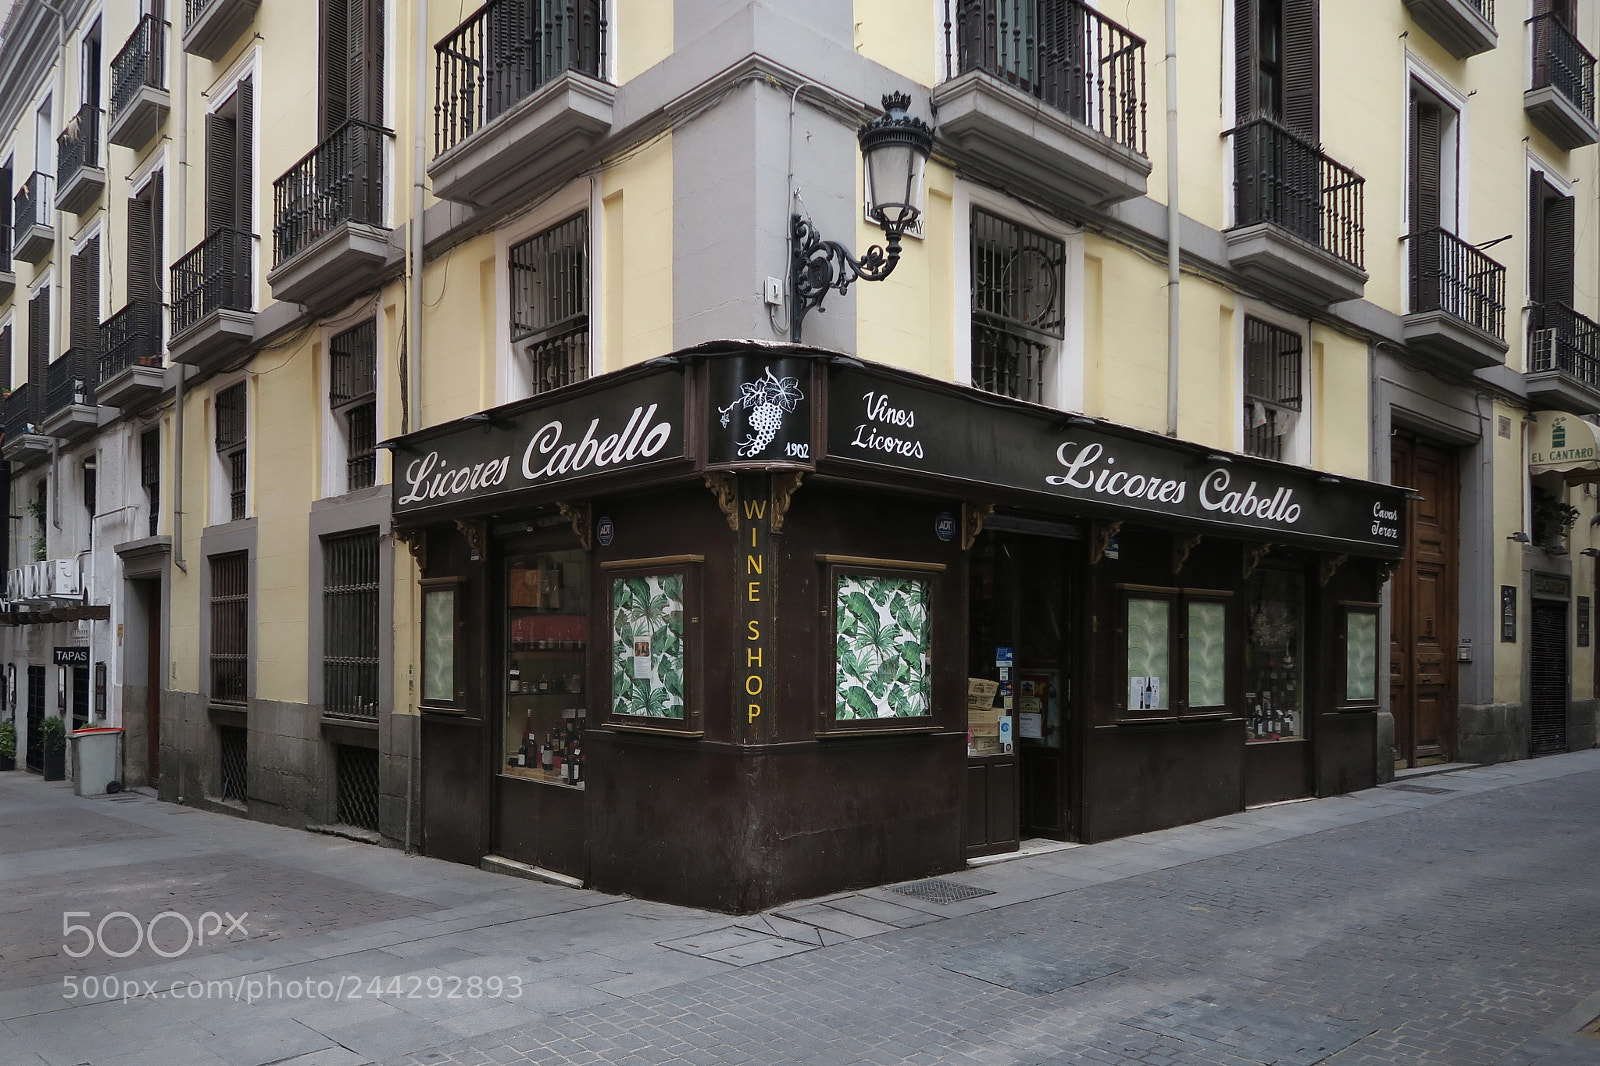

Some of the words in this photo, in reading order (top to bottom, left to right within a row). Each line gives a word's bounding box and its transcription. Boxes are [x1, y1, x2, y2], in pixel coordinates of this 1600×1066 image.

[863, 392, 915, 428] Vinos
[784, 442, 810, 458] 1902
[851, 424, 924, 459] Licores
[399, 451, 511, 505] Licores
[521, 403, 671, 480] Cabello
[1531, 452, 1544, 463] EL
[1549, 447, 1593, 461] CANTARO
[1045, 440, 1187, 504] Licores
[1199, 468, 1301, 524] Cabello
[1373, 501, 1398, 521] Cavas
[599, 524, 611, 535] ADT
[938, 520, 952, 531] ADT
[1371, 519, 1398, 539] Jerez
[743, 499, 767, 602] WINE
[55, 650, 87, 661] TAPAS
[745, 620, 763, 724] SHOP
